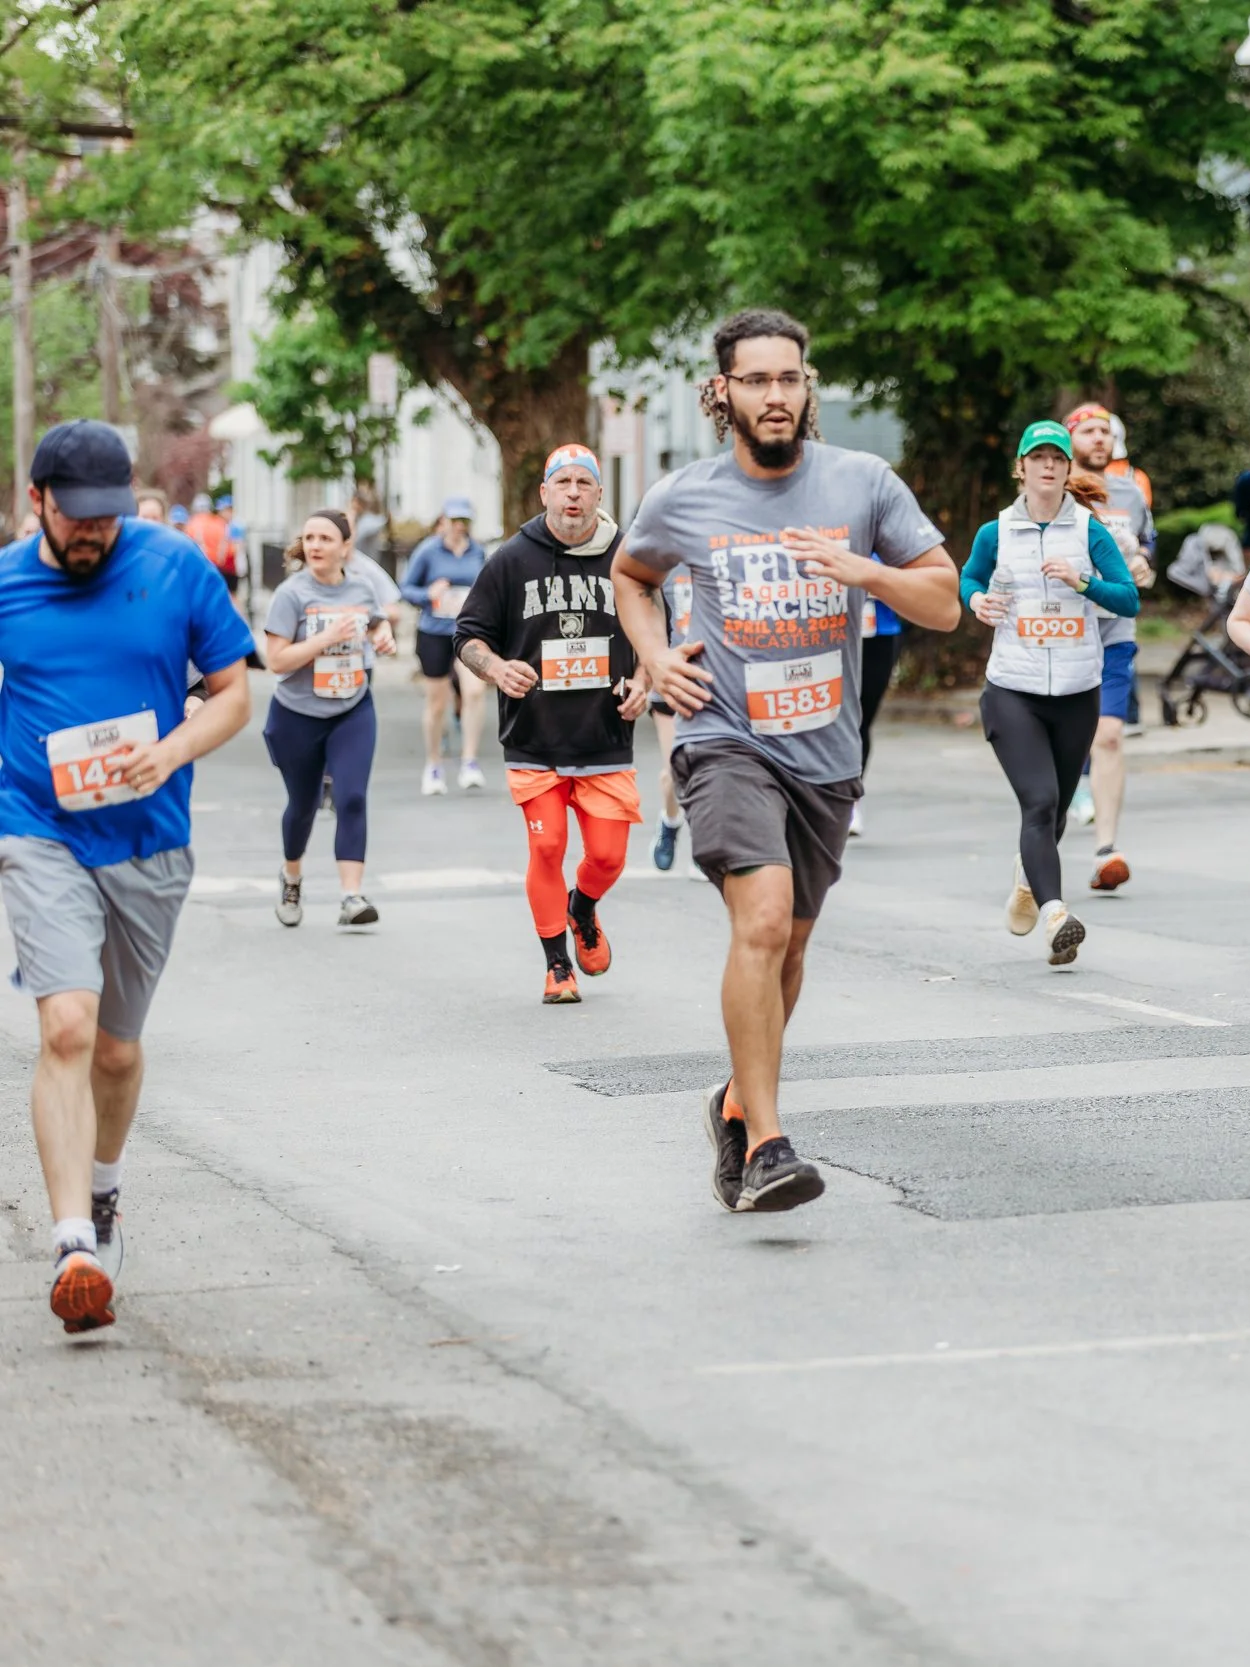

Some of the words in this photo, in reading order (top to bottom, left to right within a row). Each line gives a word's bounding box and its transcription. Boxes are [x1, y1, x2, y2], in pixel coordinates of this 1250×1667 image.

[733, 532, 776, 545] Years
[523, 574, 616, 619] ARMY
[742, 579, 844, 604] against
[737, 596, 849, 621] RACISM
[724, 618, 771, 634] APRIL
[1022, 619, 1079, 636] 1090
[829, 628, 847, 643] PA
[556, 659, 598, 677] 344
[763, 683, 832, 718] 1583
